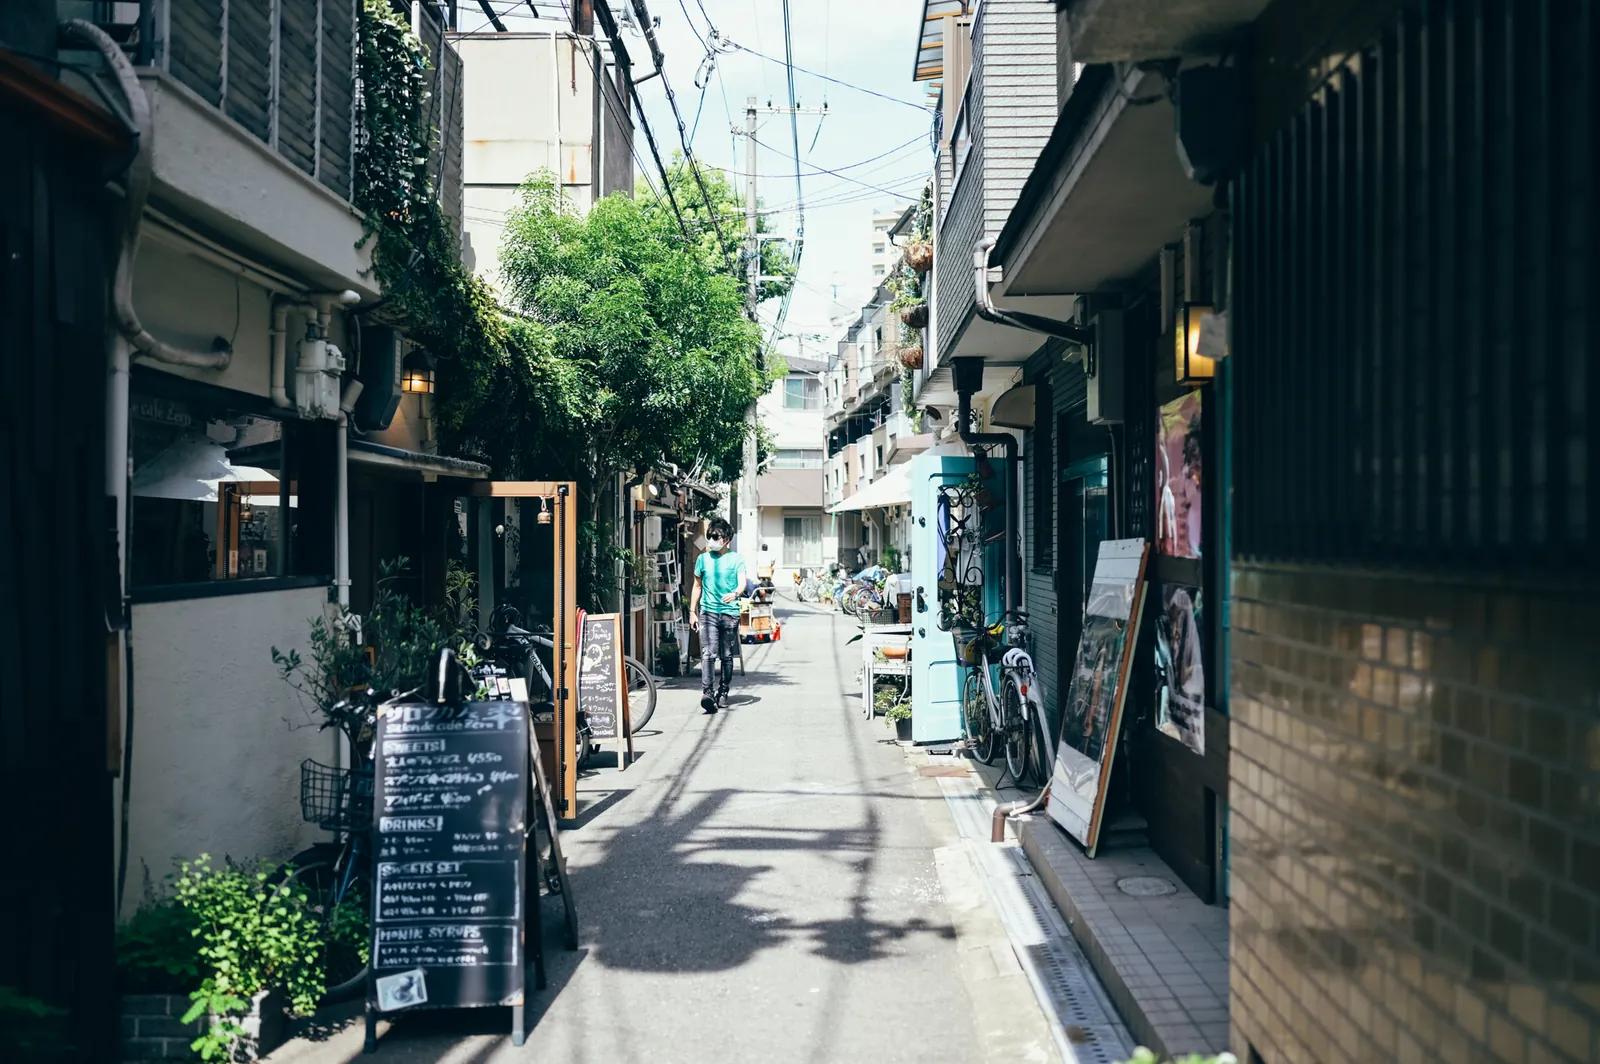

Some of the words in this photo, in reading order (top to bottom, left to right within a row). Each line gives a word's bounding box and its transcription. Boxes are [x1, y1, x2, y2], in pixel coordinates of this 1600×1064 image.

[384, 818, 437, 831] DRINKS
[381, 862, 433, 876] SWEETS
[436, 861, 460, 874] SET
